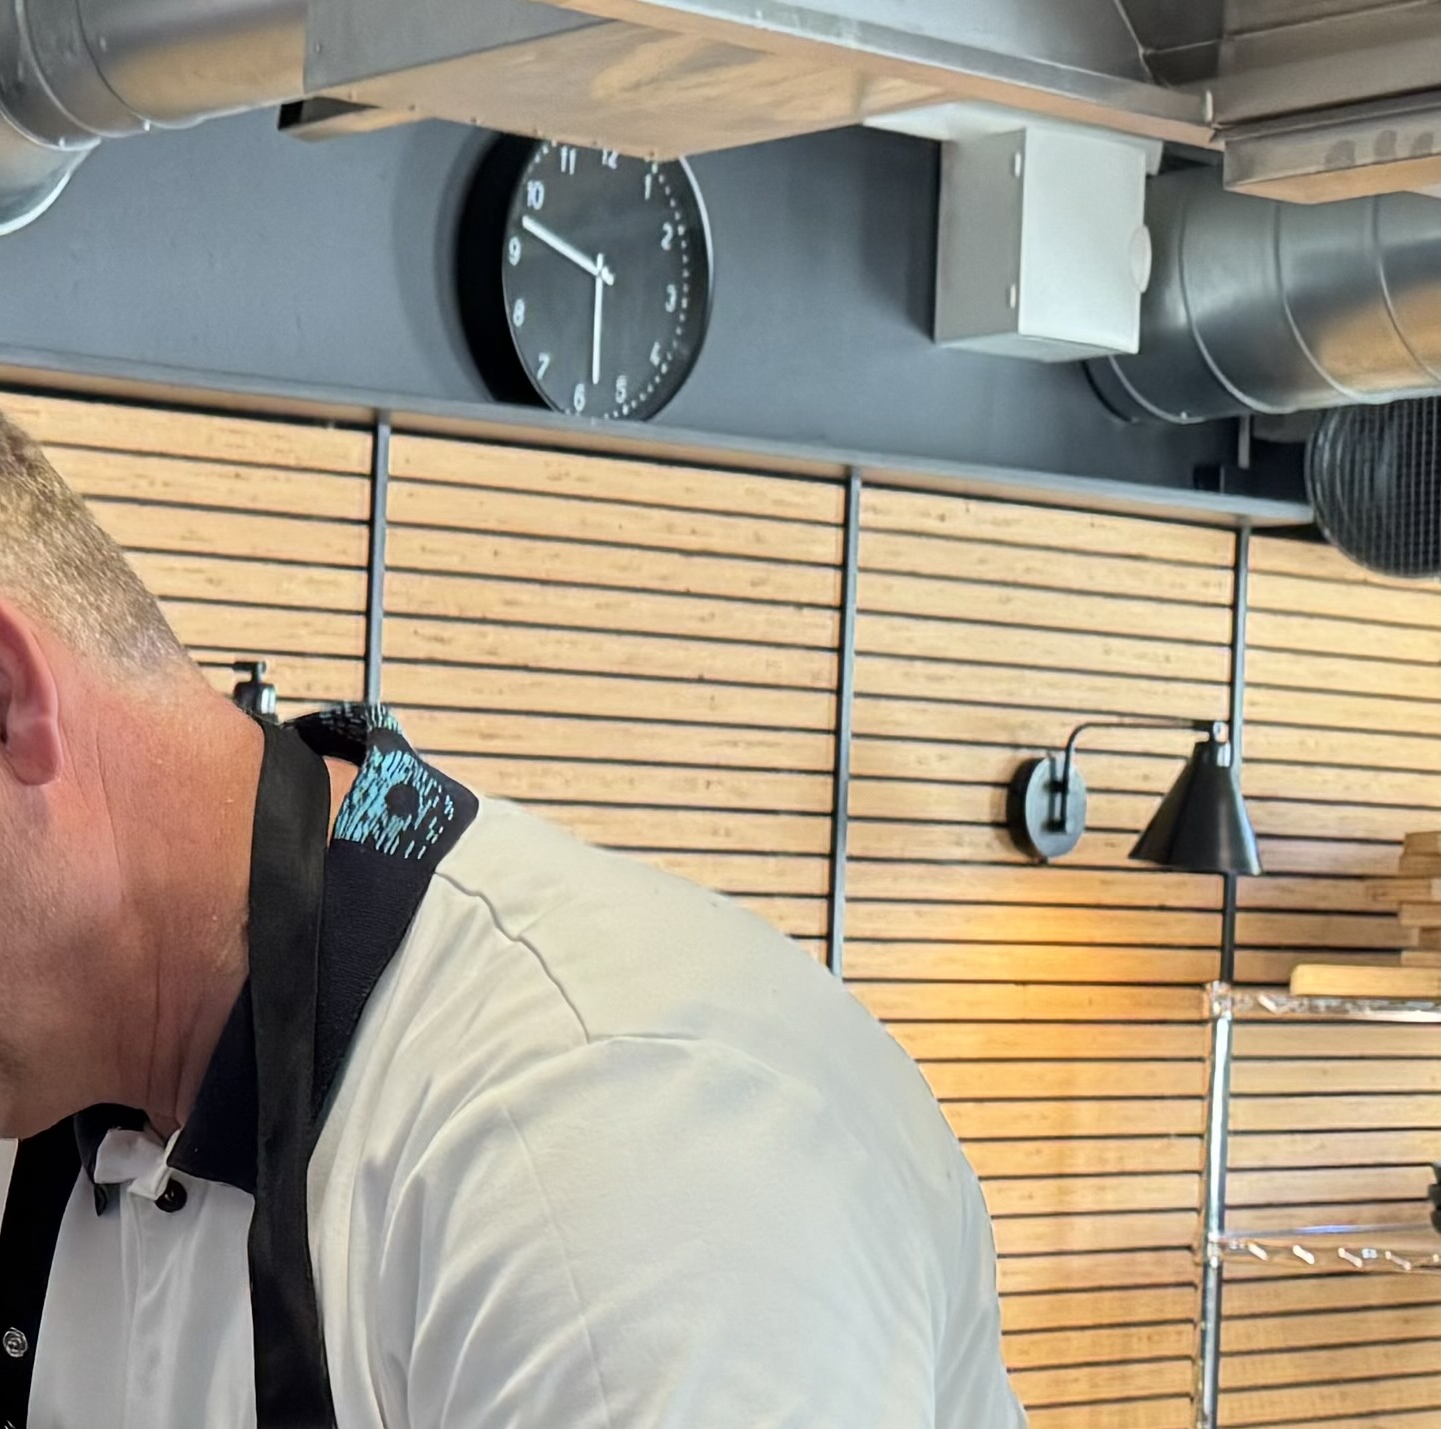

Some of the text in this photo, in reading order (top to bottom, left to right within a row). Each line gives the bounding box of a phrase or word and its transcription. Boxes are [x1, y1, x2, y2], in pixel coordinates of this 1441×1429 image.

[526, 180, 545, 210] 10
[508, 236, 521, 266] 9
[660, 222, 675, 251] 2
[512, 298, 526, 327] 8
[664, 284, 677, 313] 3
[536, 352, 551, 380] 7
[649, 341, 662, 367] 4
[573, 383, 586, 412] 6
[616, 375, 628, 404] 5
